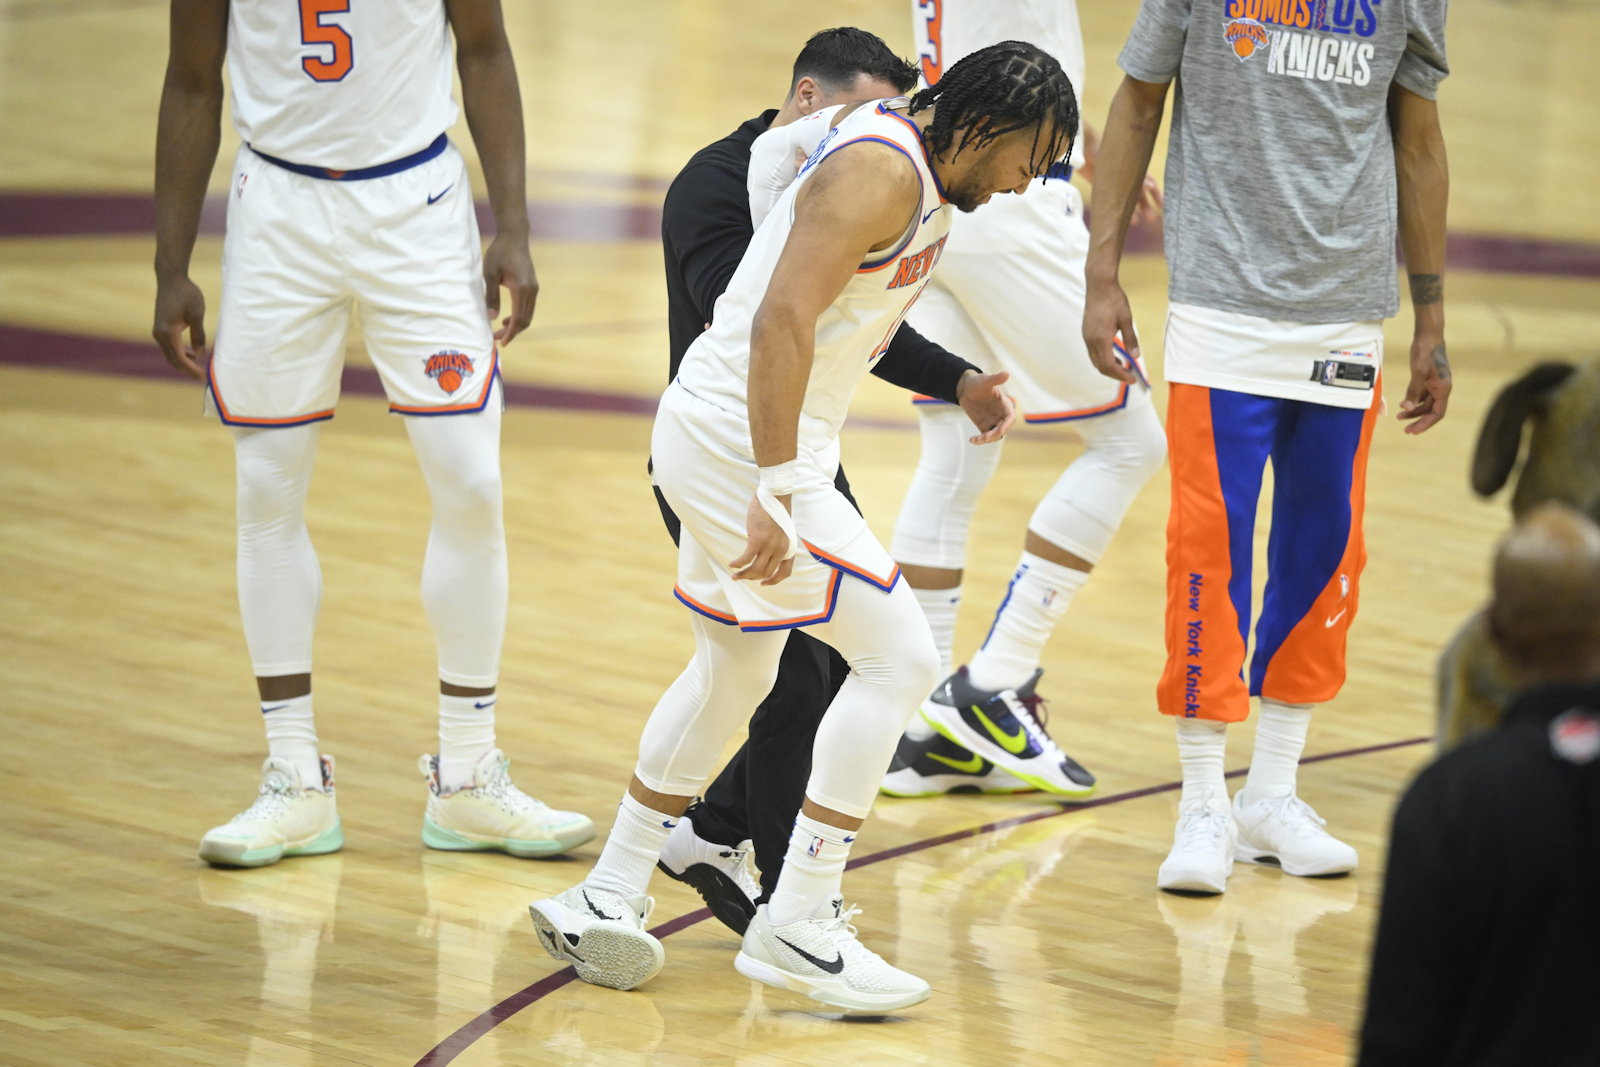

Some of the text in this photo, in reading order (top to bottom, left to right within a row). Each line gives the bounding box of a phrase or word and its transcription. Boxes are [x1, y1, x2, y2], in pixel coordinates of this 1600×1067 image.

[298, 0, 354, 83] 5
[919, 0, 943, 90] 3
[1224, 21, 1268, 45] KNICKS
[1267, 29, 1375, 87] KNICKS
[1185, 572, 1203, 718] New York Knicks
